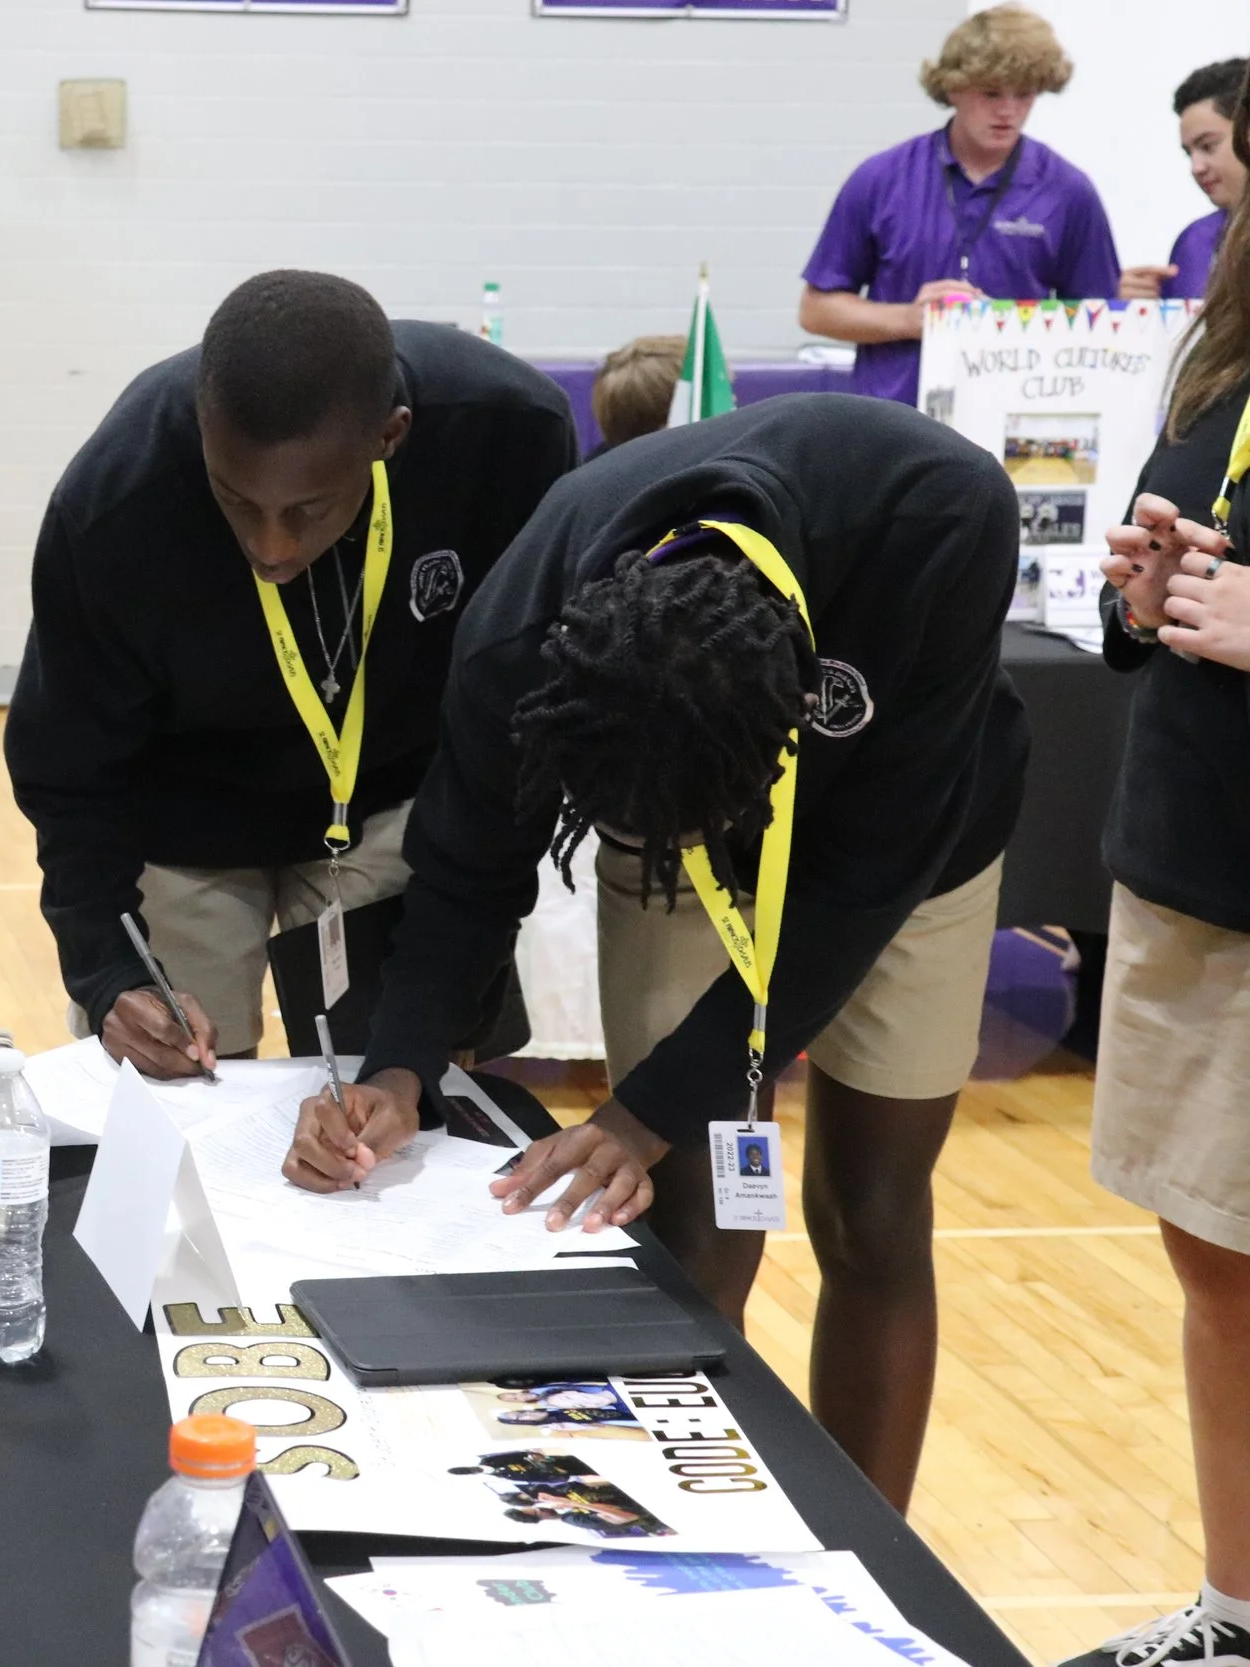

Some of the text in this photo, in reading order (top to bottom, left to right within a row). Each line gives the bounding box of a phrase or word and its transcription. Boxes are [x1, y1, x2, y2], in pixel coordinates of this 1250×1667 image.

[961, 347, 1041, 378] WORLD
[1020, 375, 1085, 399] CLUB
[726, 1142, 736, 1172] 2022-23
[742, 1182, 769, 1191] Daevyn
